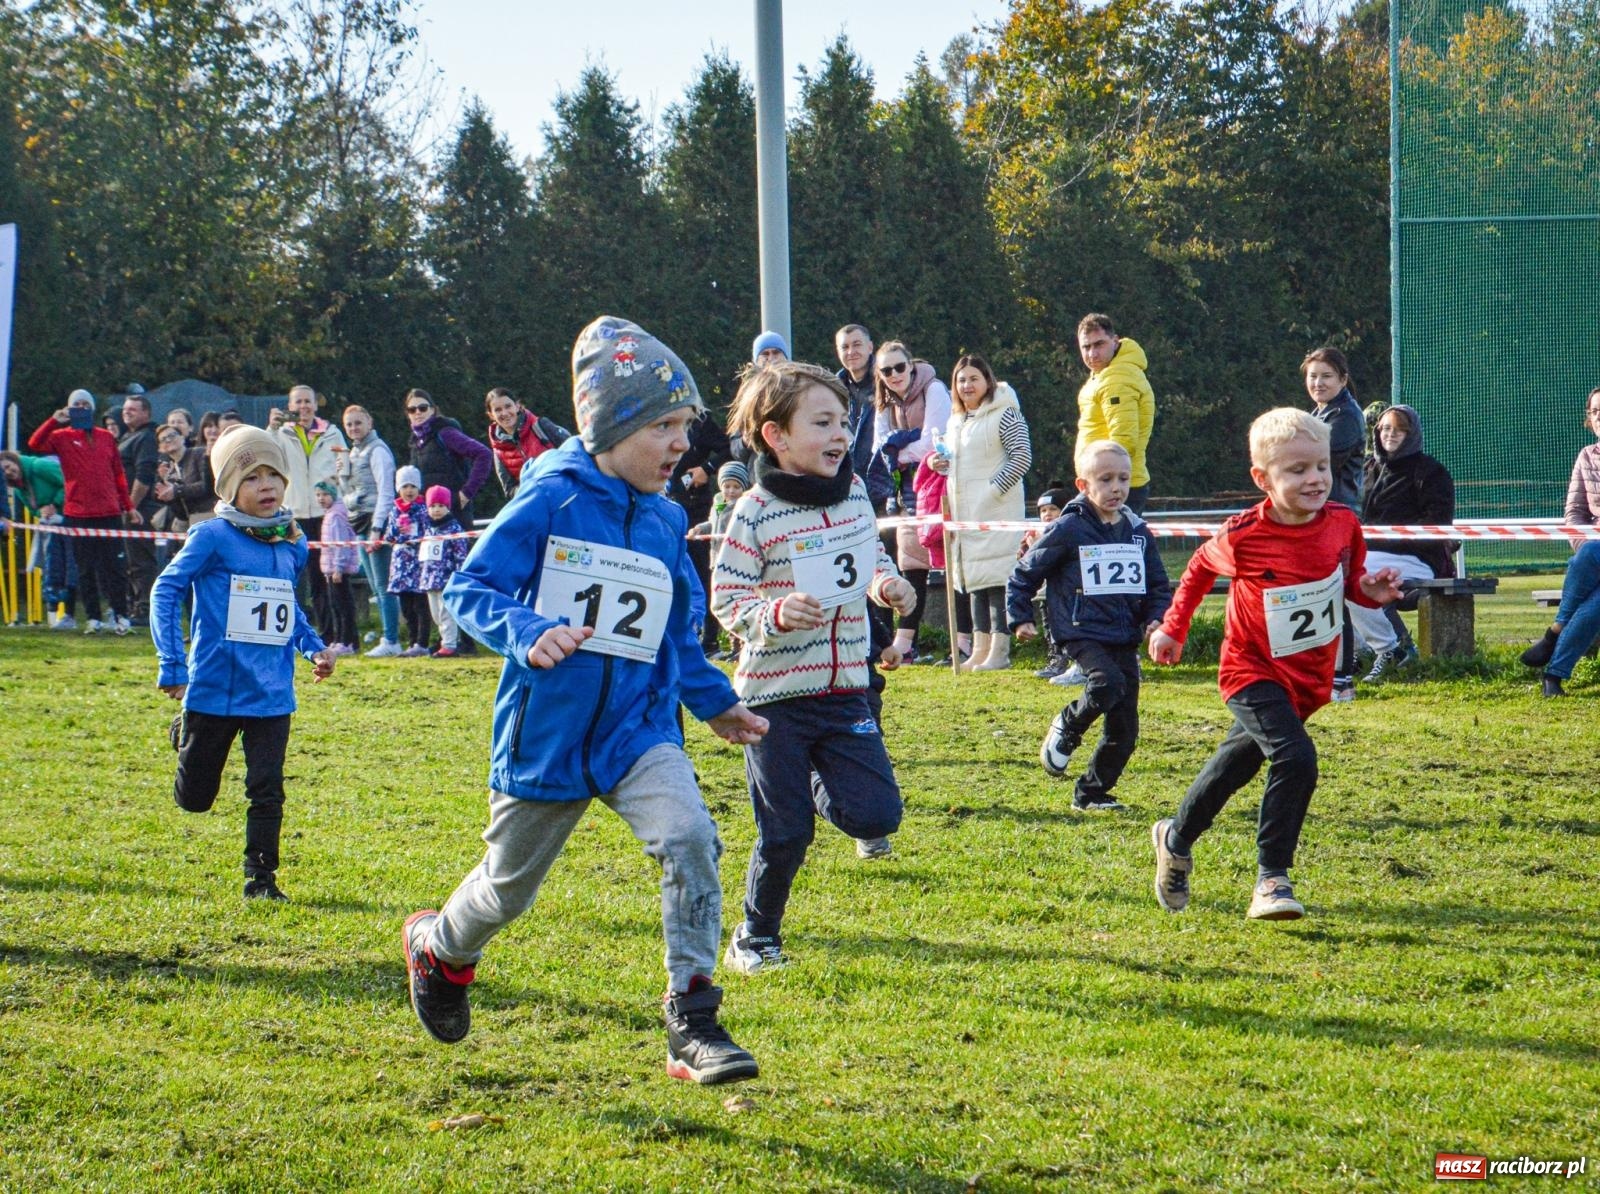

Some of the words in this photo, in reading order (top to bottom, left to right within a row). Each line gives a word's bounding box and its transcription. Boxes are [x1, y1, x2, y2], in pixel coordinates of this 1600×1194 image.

[834, 552, 858, 588] 3
[1087, 562, 1142, 585] 123
[251, 602, 289, 633] 19
[574, 583, 647, 639] 12
[1289, 598, 1336, 641] 21
